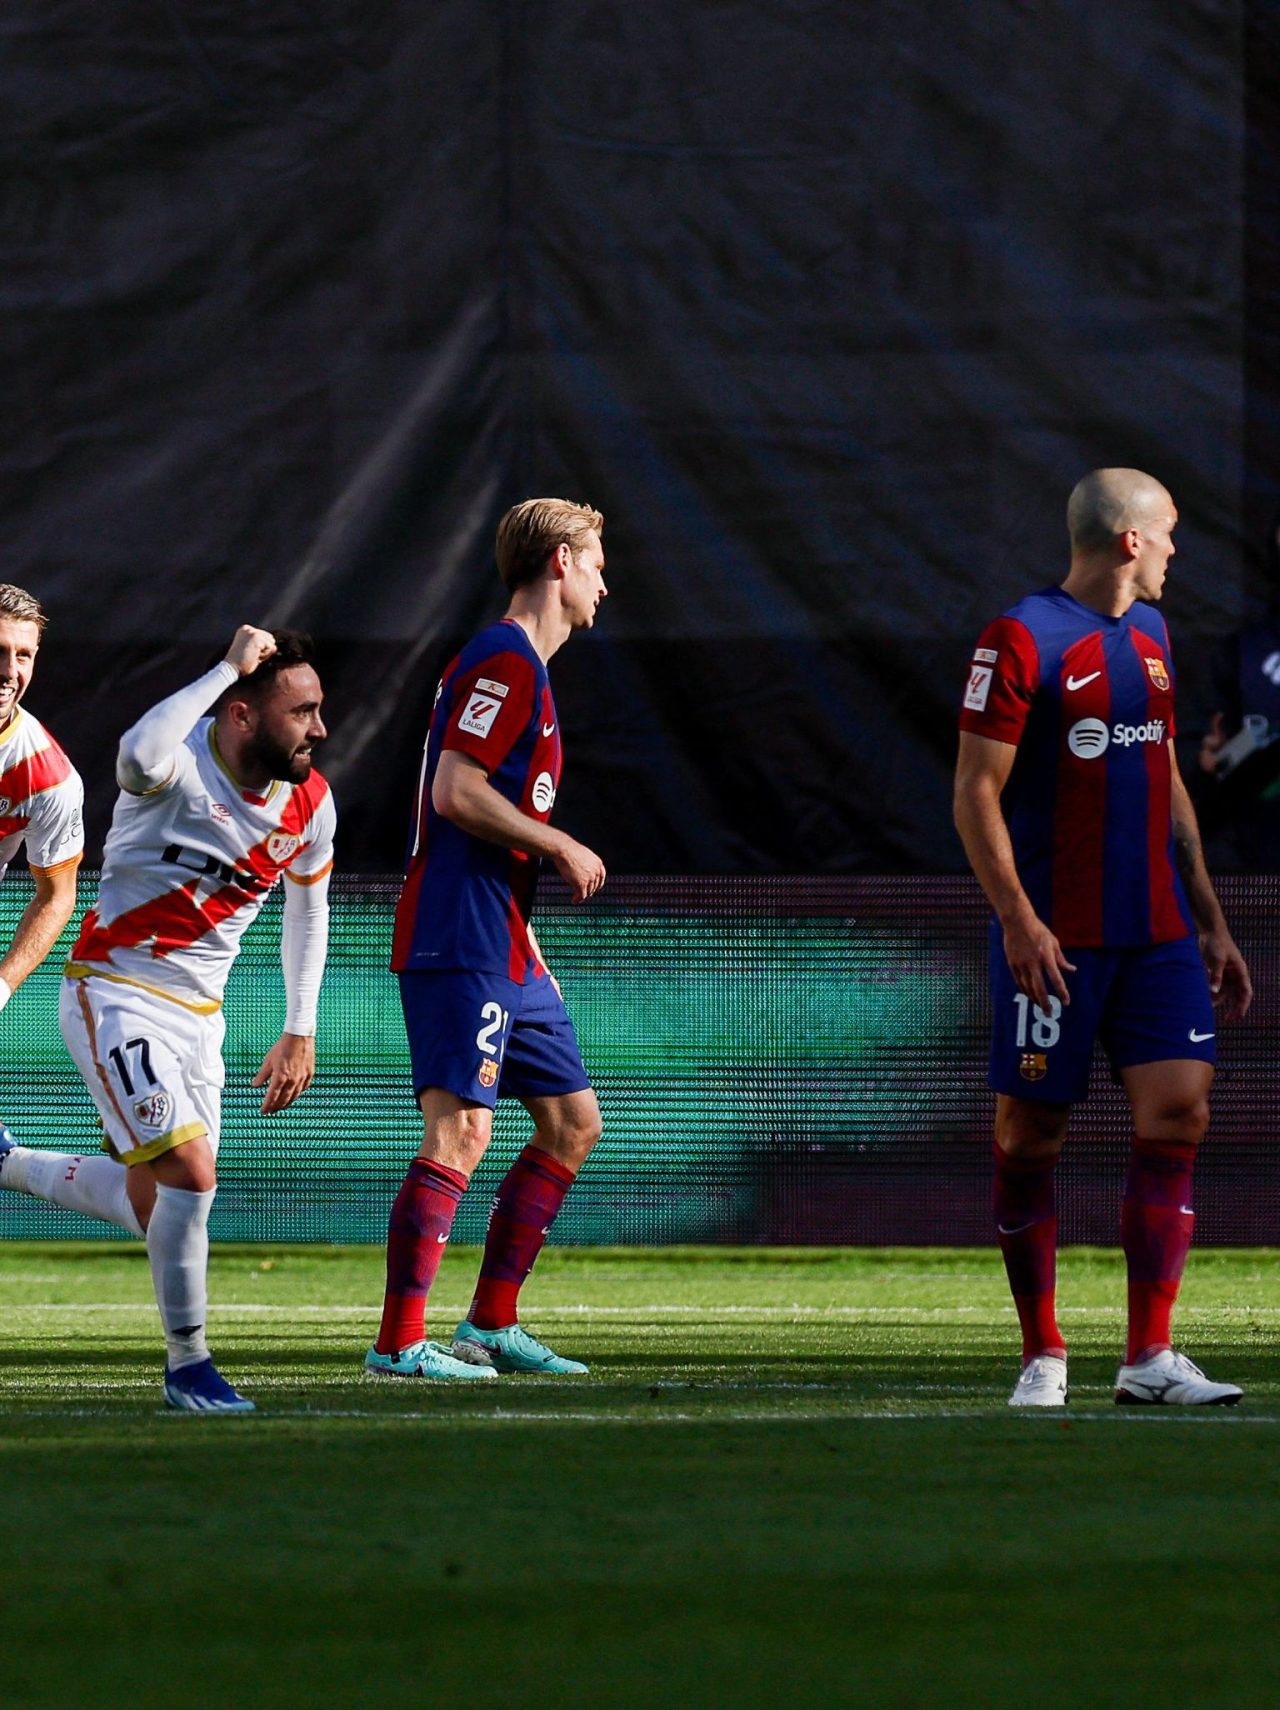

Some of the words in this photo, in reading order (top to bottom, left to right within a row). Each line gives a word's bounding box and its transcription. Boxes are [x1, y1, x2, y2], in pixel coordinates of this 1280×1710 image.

[1112, 719, 1166, 747] Spotify
[1013, 993, 1062, 1048] 18
[108, 1037, 158, 1097] 17
